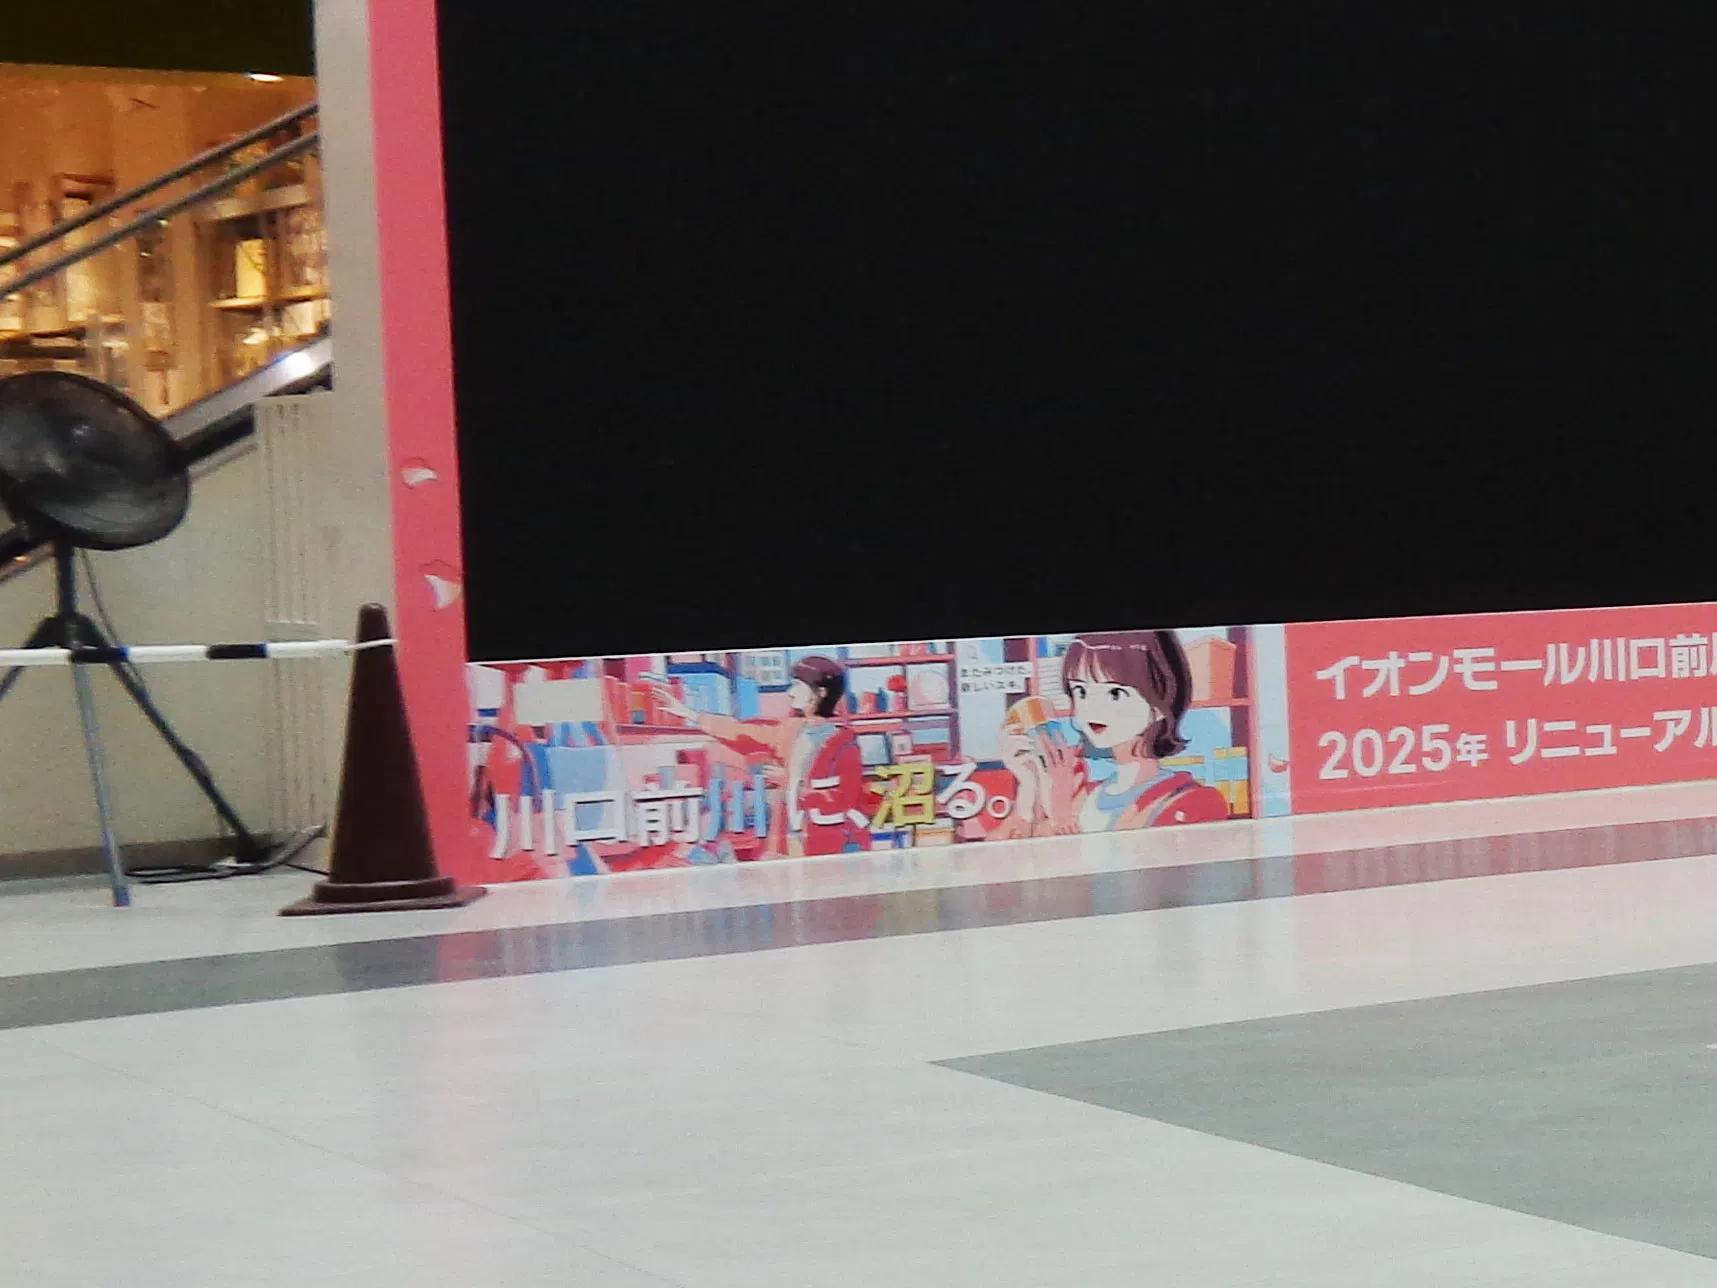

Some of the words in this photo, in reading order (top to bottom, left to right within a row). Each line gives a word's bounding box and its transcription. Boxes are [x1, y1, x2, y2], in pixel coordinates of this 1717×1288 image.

[1318, 726, 1489, 781] 2025年
[491, 760, 1013, 860] 川口前川に、沼る。
